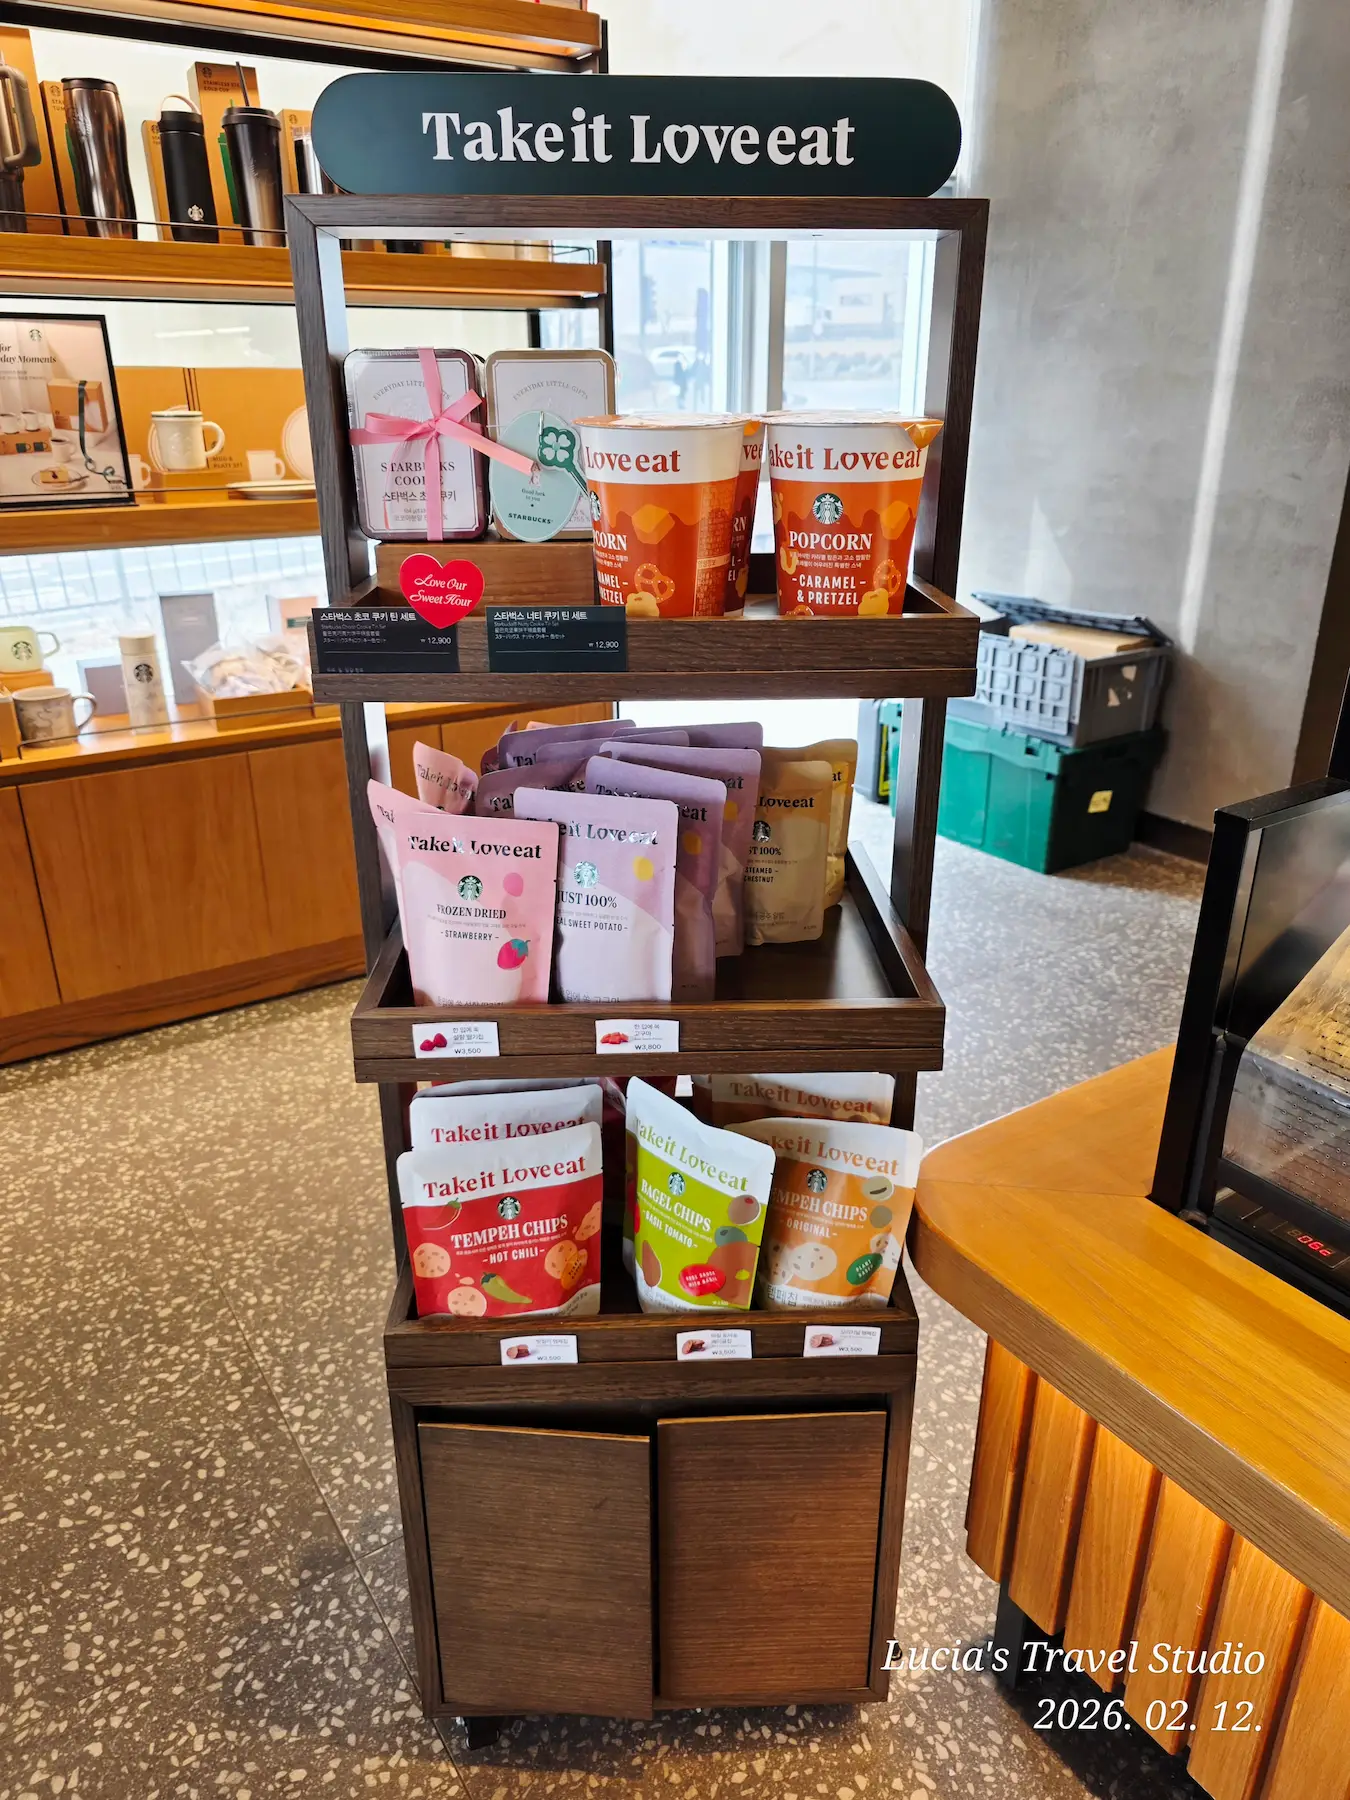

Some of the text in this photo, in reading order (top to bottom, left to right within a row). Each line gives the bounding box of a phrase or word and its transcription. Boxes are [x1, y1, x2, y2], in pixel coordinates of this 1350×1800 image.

[18, 355, 57, 364] Moments
[373, 380, 405, 401] EVERYDAY
[769, 445, 793, 469] ake
[508, 512, 552, 524] STARBUCKS
[593, 530, 627, 551] CORN
[788, 530, 873, 550] POPCORN
[414, 573, 468, 591] Love Our
[799, 574, 856, 589] CARAMEL
[409, 589, 473, 607] Sweet Hour
[796, 589, 858, 606] & PRETZEL
[320, 612, 416, 622] 스타벅스 초코 쿠키 틴 세트
[494, 611, 588, 621] 스타벅스 너티 쿠키 틴 세트
[585, 894, 618, 909] 100%
[436, 904, 506, 920] FROZEN DRIED
[568, 918, 591, 929] SWEET
[594, 922, 623, 932] POTATO
[444, 930, 493, 941] STRAWBERRY
[641, 1178, 672, 1214] BAGEL
[673, 1202, 712, 1233] CHIPS
[822, 1200, 869, 1222] CHIPS
[450, 1224, 520, 1249] TEMPEH
[522, 1214, 569, 1237] CHIPS
[645, 1210, 663, 1231] BASIL
[664, 1224, 694, 1249] TOMATO
[786, 1218, 831, 1239] ORIGINAL
[489, 1246, 539, 1265] HOT CHILI
